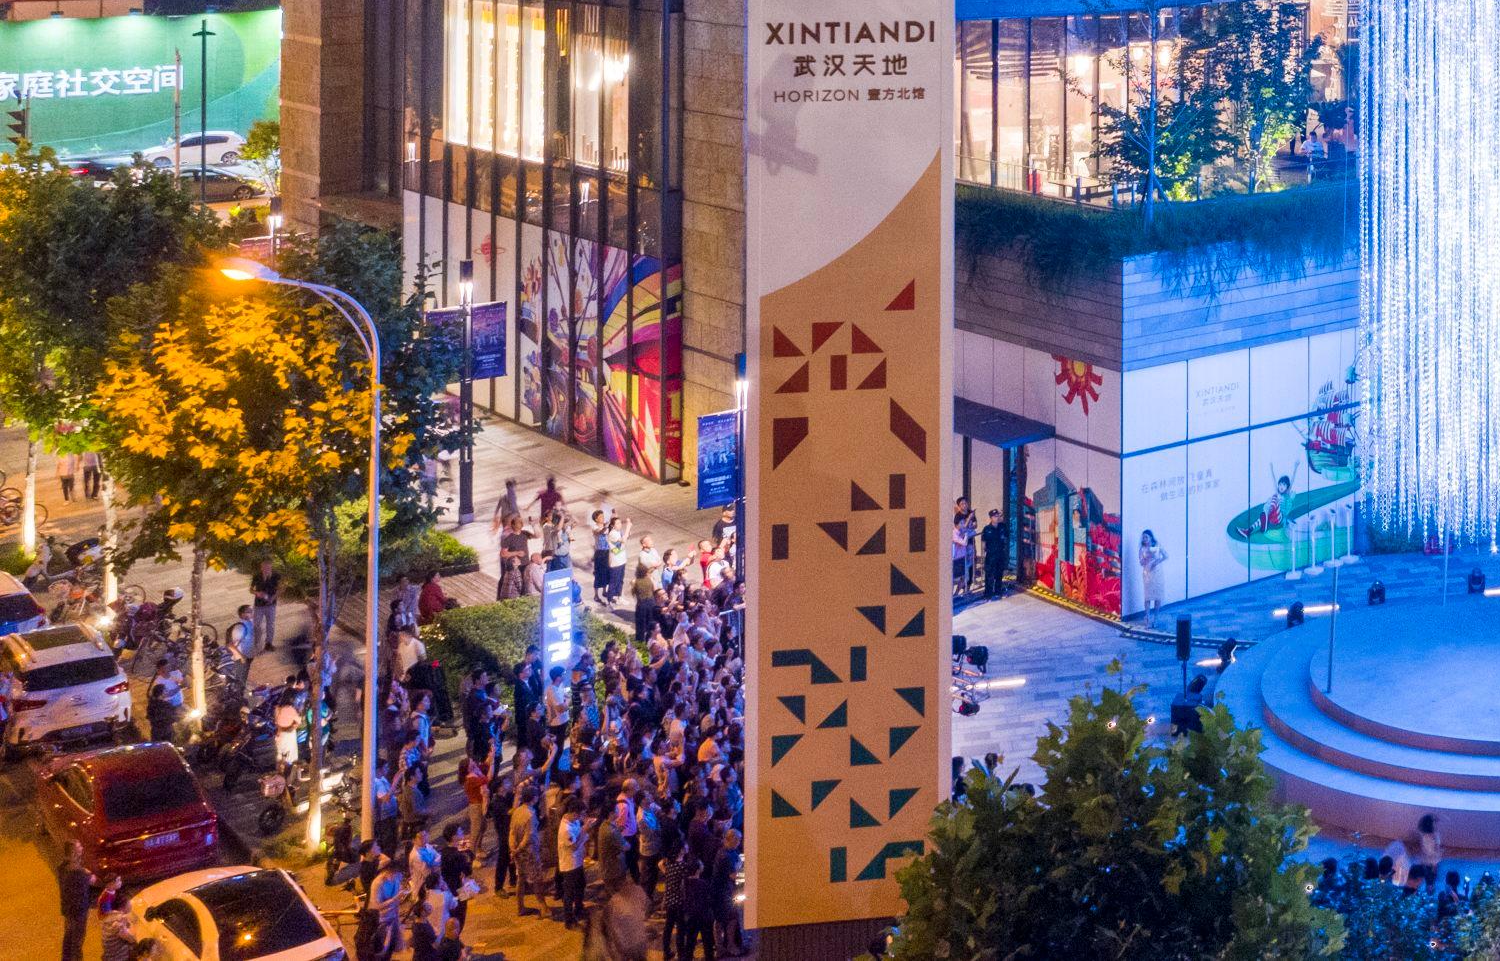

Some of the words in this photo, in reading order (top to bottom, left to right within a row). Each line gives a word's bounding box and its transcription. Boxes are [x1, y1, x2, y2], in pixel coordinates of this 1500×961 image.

[765, 20, 935, 45] XINTIANDI
[793, 53, 908, 77] 武汉天地
[0, 64, 184, 102] 家庭社交空间
[774, 89, 860, 103] HORIZON
[867, 87, 926, 101] 壹方北馆
